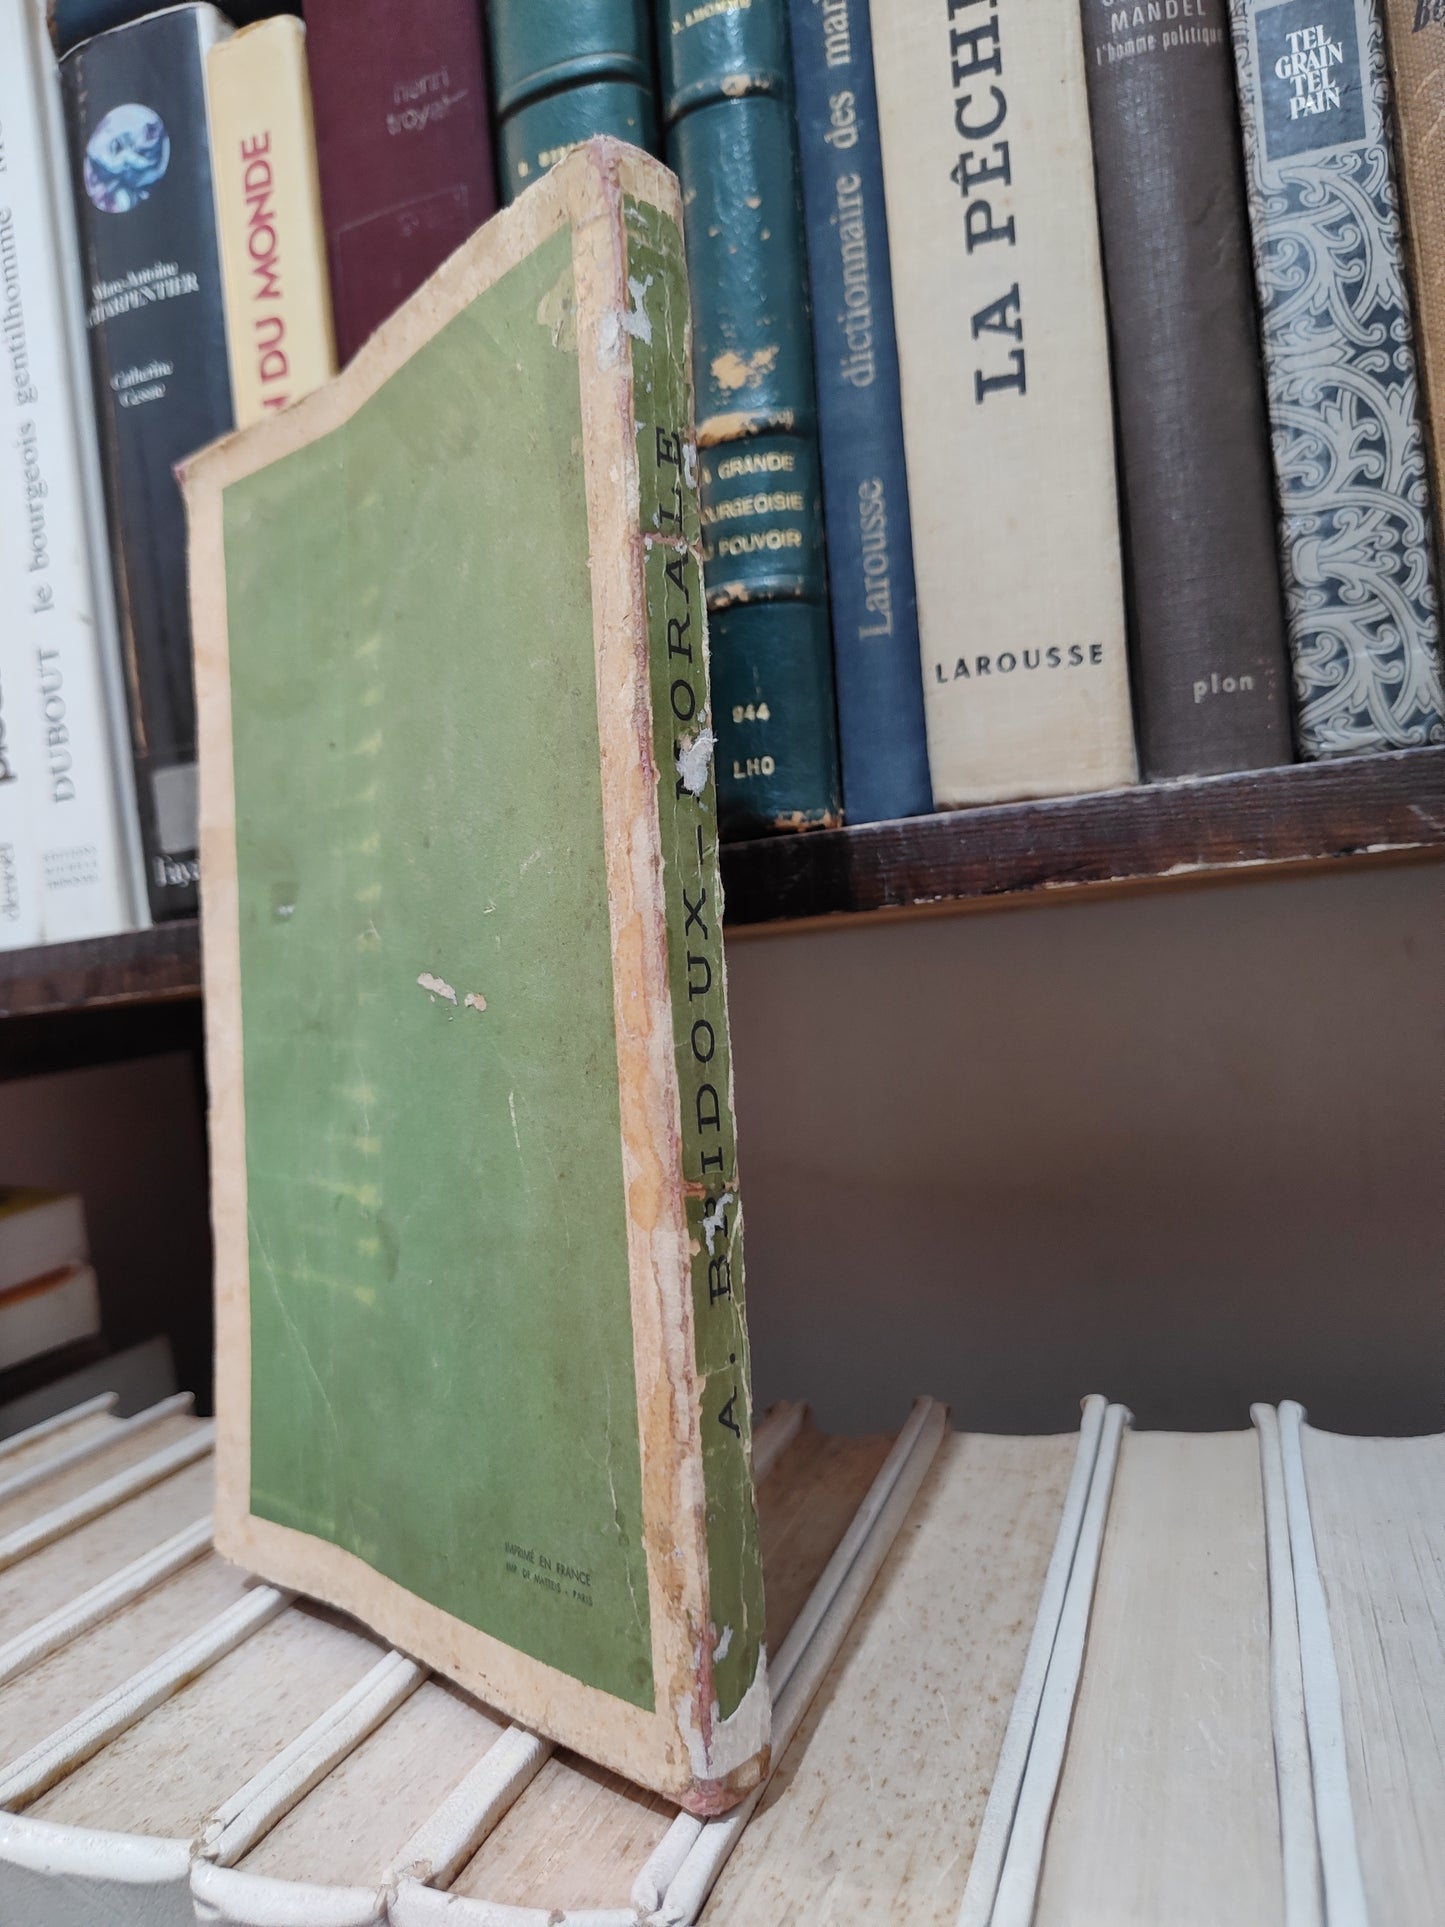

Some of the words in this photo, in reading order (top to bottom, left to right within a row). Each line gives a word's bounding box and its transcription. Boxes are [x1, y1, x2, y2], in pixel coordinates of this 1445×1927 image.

[812, 0, 850, 69] mar
[1110, 0, 1206, 33] MANDEL
[1096, 34, 1156, 66] l'homme
[1162, 25, 1224, 51] politique
[1285, 24, 1332, 54] TEL
[1275, 41, 1344, 79] GRAIN
[1289, 67, 1337, 97] TEL
[823, 91, 859, 150] des
[1290, 87, 1341, 120] PAIN
[240, 130, 282, 300] MONDE
[839, 172, 876, 388] dictionnaire
[0, 206, 38, 406] gentilhomme
[255, 316, 289, 382] DU
[971, 283, 1026, 404] LA
[717, 451, 796, 480] GRANDE
[15, 420, 49, 573] bourgeois
[718, 528, 803, 557] POUVOIR
[859, 475, 894, 642] Larousse
[32, 583, 54, 615] le
[935, 642, 1103, 684] LAROUSSE
[1193, 672, 1254, 704] plon
[37, 646, 76, 804] DUBOUT
[733, 755, 775, 779] LHO
[718, 1351, 742, 1439] A.
[539, 1555, 552, 1571] EN
[556, 1562, 592, 1587] FRANCE
[572, 1590, 593, 1607] PARIS
